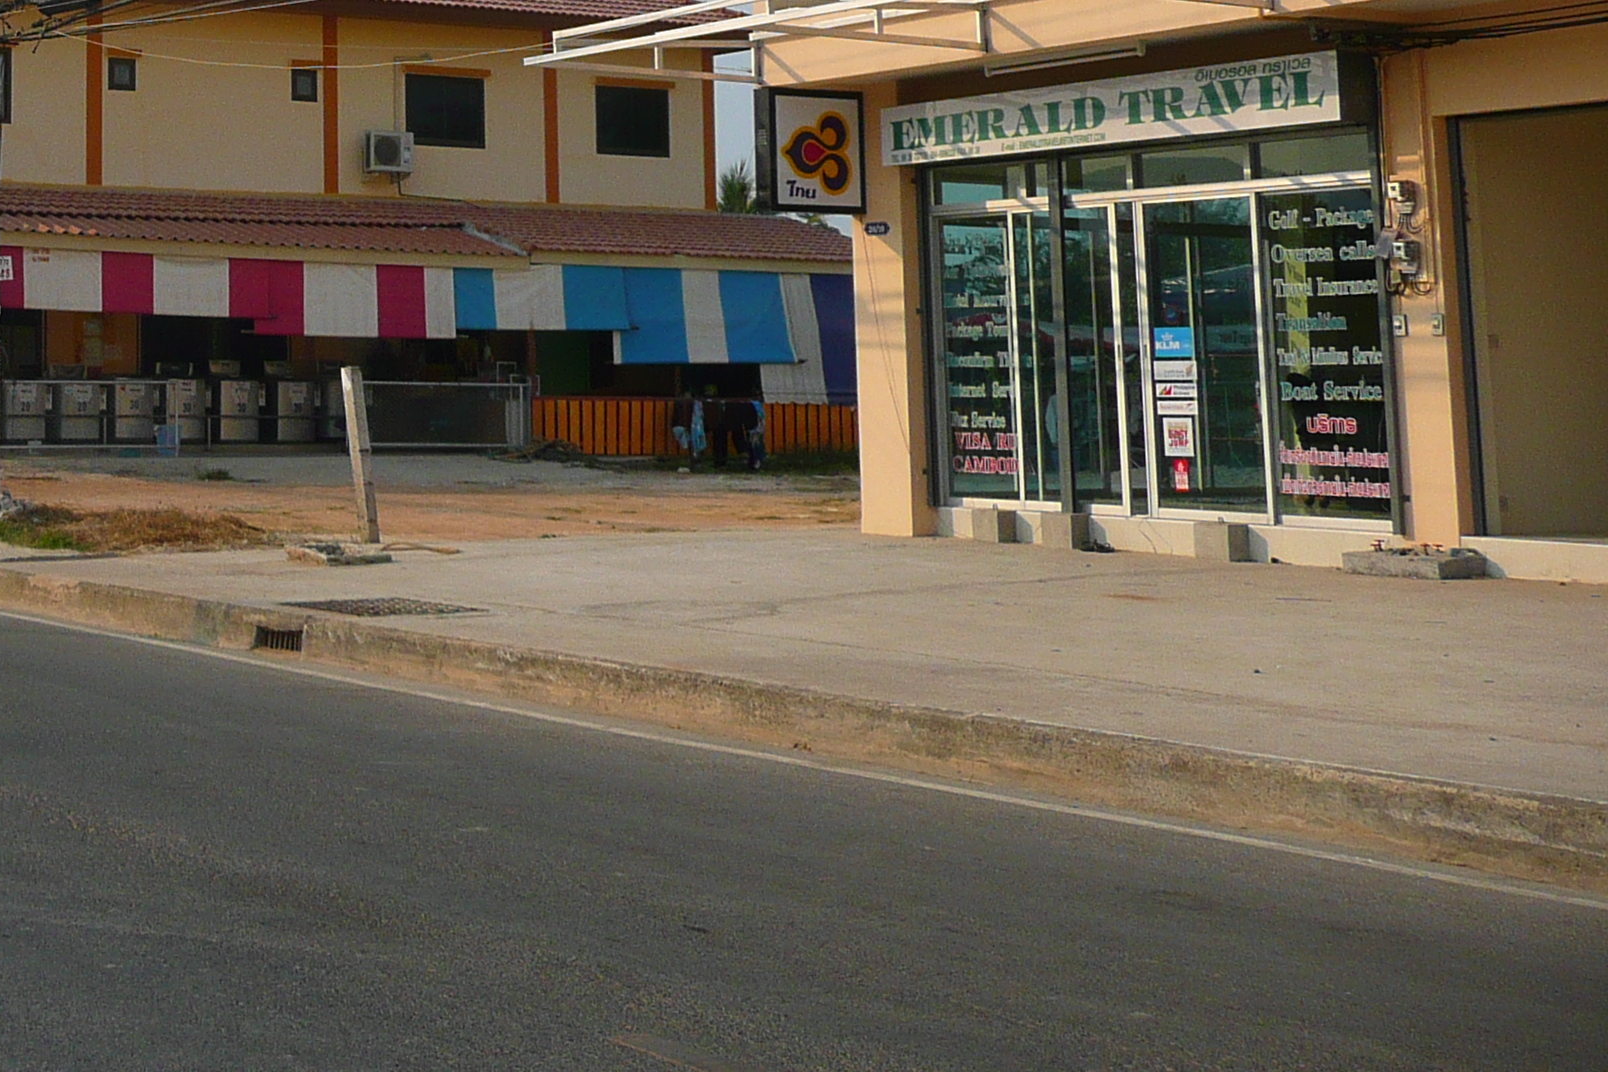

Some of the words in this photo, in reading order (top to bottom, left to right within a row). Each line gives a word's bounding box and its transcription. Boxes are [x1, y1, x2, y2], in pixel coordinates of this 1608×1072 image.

[890, 96, 1106, 152] EMERALD
[1118, 70, 1325, 125] TRAVEL
[1268, 209, 1299, 229] Golf
[1315, 207, 1373, 229] Package
[1271, 244, 1334, 263] Oversea
[1273, 277, 1313, 297] Travel
[1316, 277, 1379, 296] Insurance
[1155, 340, 1180, 350] KLM
[1280, 382, 1318, 401] Boat
[1323, 379, 1382, 401] Service
[971, 411, 1006, 428] Service
[1306, 413, 1358, 434] บริการ
[955, 432, 991, 450] VISA
